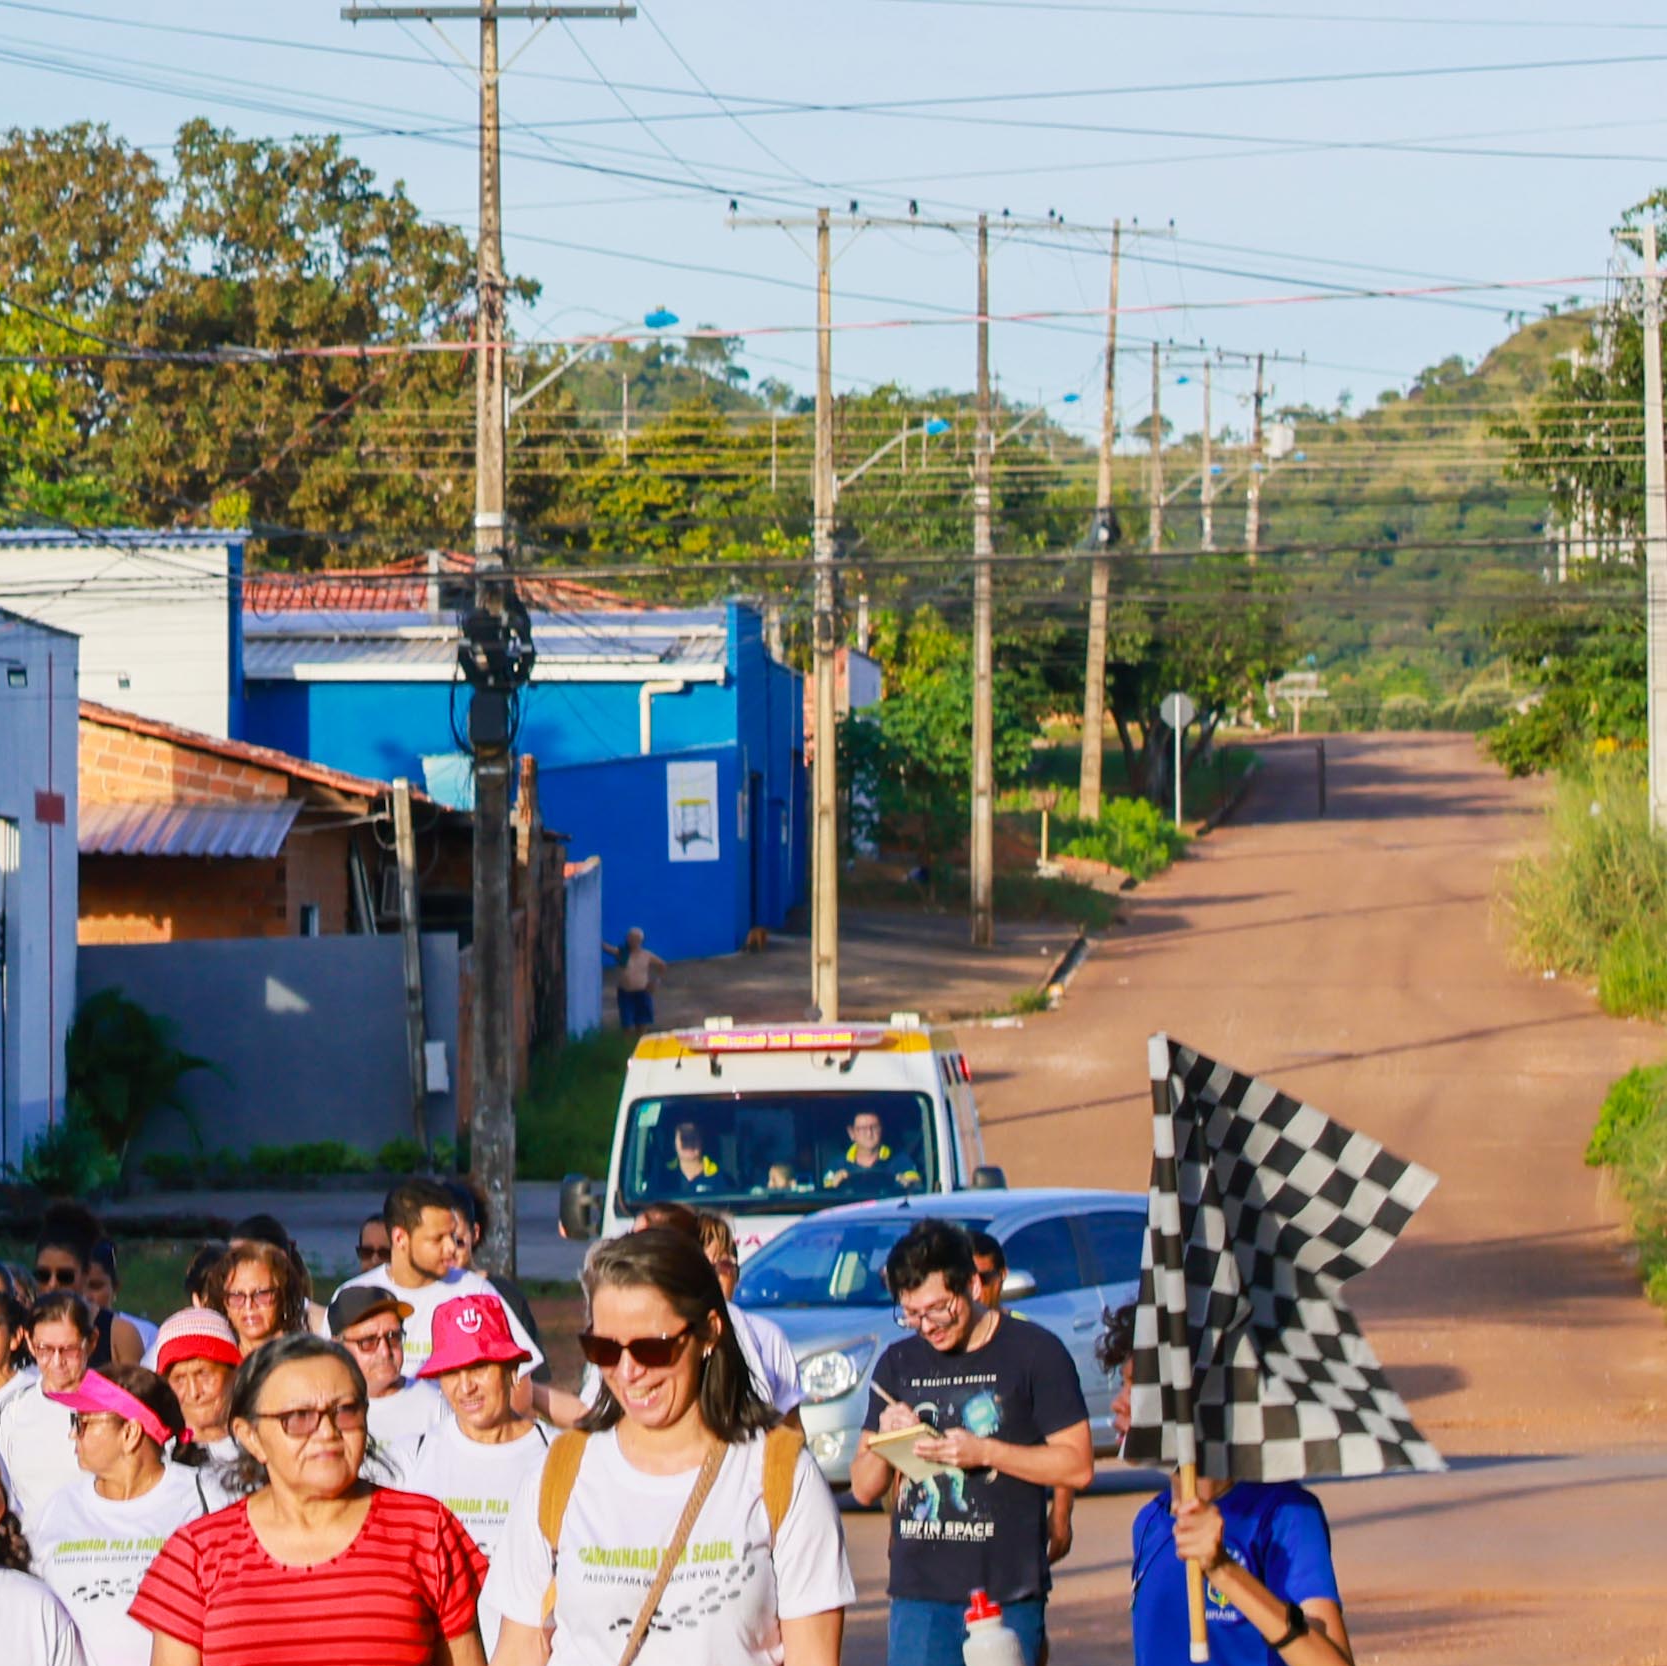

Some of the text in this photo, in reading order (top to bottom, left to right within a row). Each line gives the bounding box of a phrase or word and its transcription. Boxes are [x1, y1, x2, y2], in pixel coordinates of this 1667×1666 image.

[945, 1521, 994, 1537] SPACE
[578, 1544, 657, 1571] CAMINHADA
[692, 1537, 734, 1564] SAÚDE
